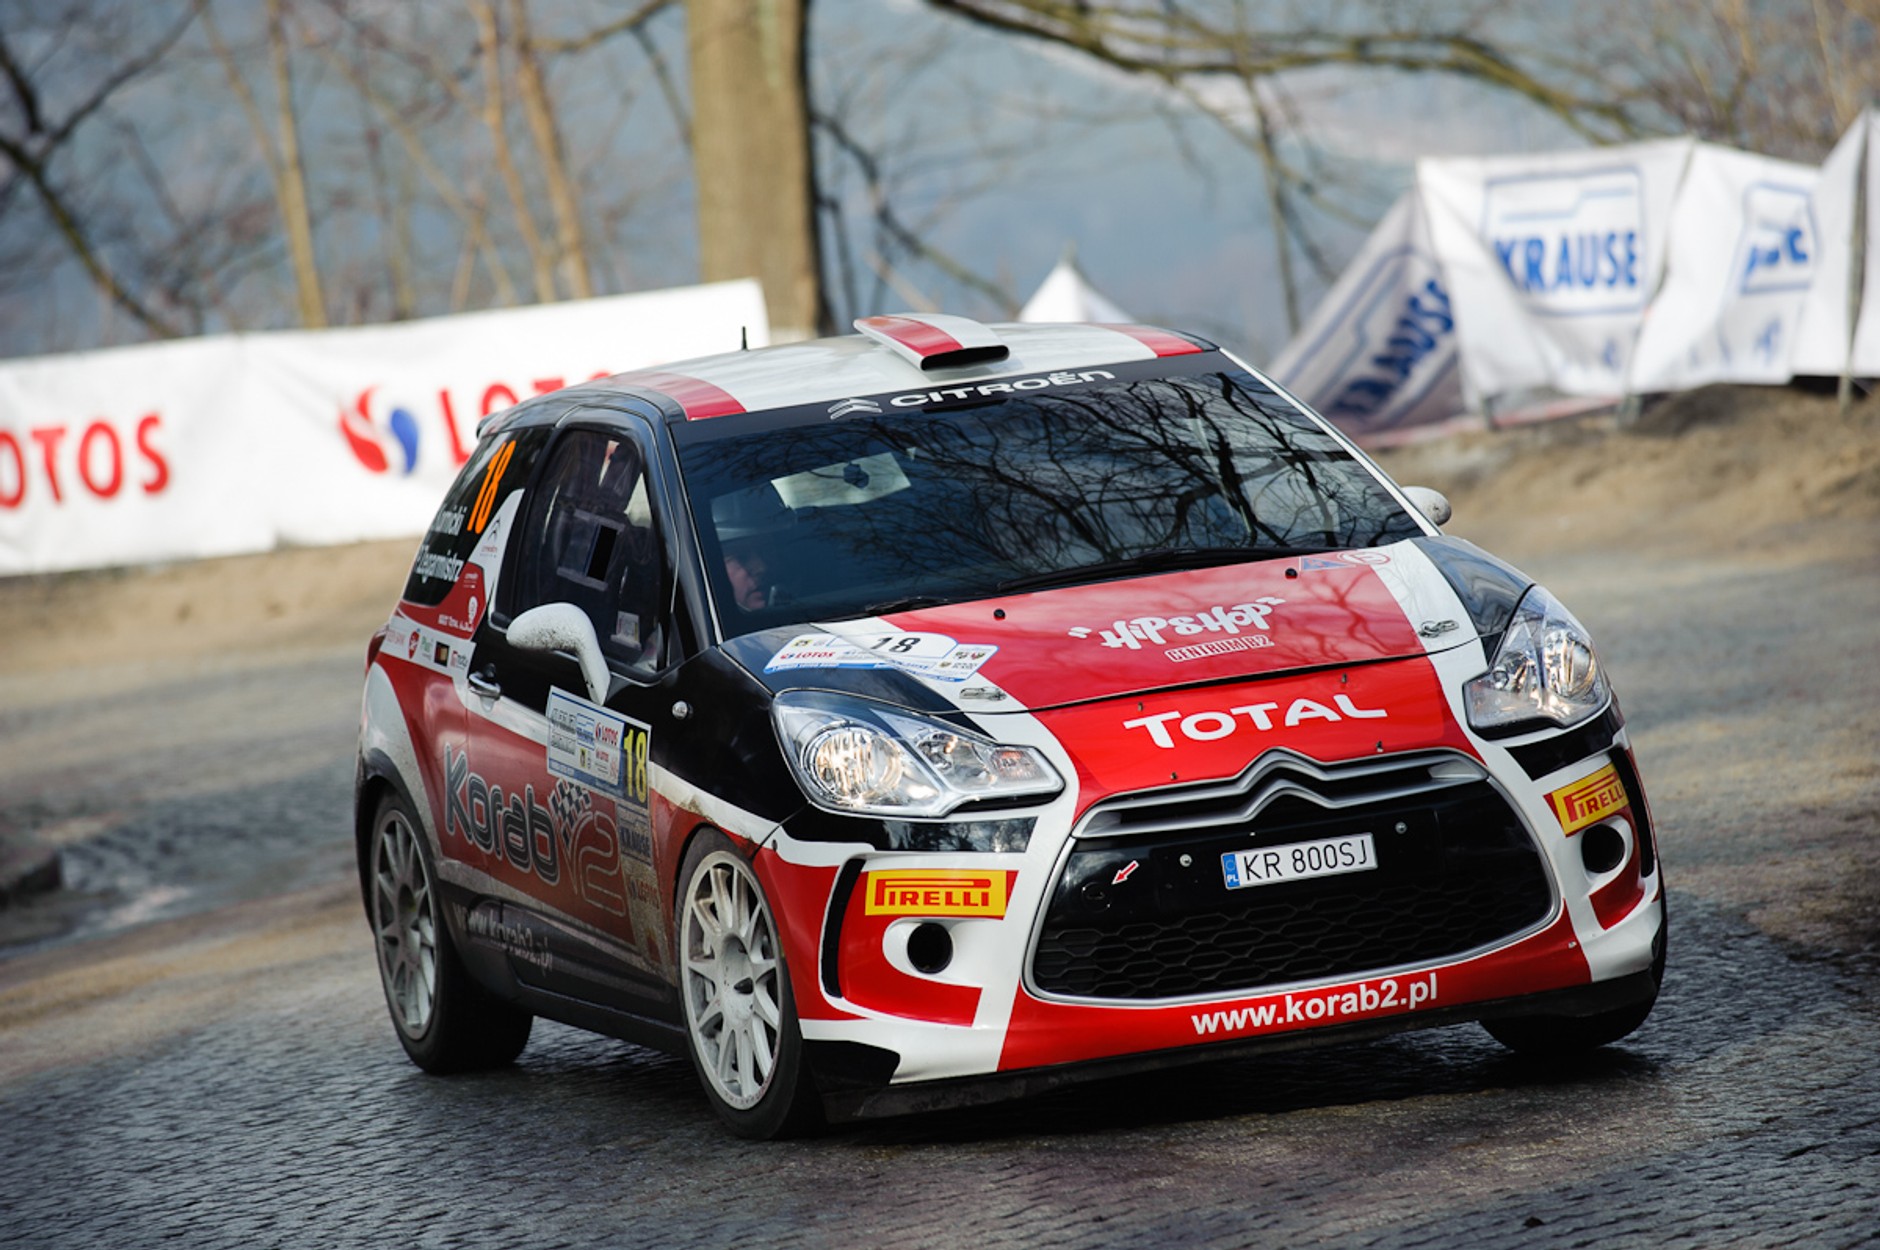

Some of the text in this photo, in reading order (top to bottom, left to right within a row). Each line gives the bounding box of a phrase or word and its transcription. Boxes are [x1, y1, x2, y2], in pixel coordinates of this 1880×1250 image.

[890, 370, 1115, 407] CITROËN
[467, 440, 516, 534] 18
[795, 651, 835, 659] LOTOS
[870, 637, 920, 652] 18
[1123, 694, 1387, 748] TOTAL
[624, 729, 647, 803] 18
[1227, 873, 1239, 883] PL
[1243, 839, 1368, 880] KR 800SJ
[874, 879, 991, 906] PIRELLI
[1191, 972, 1437, 1035] www.korab2.pl
